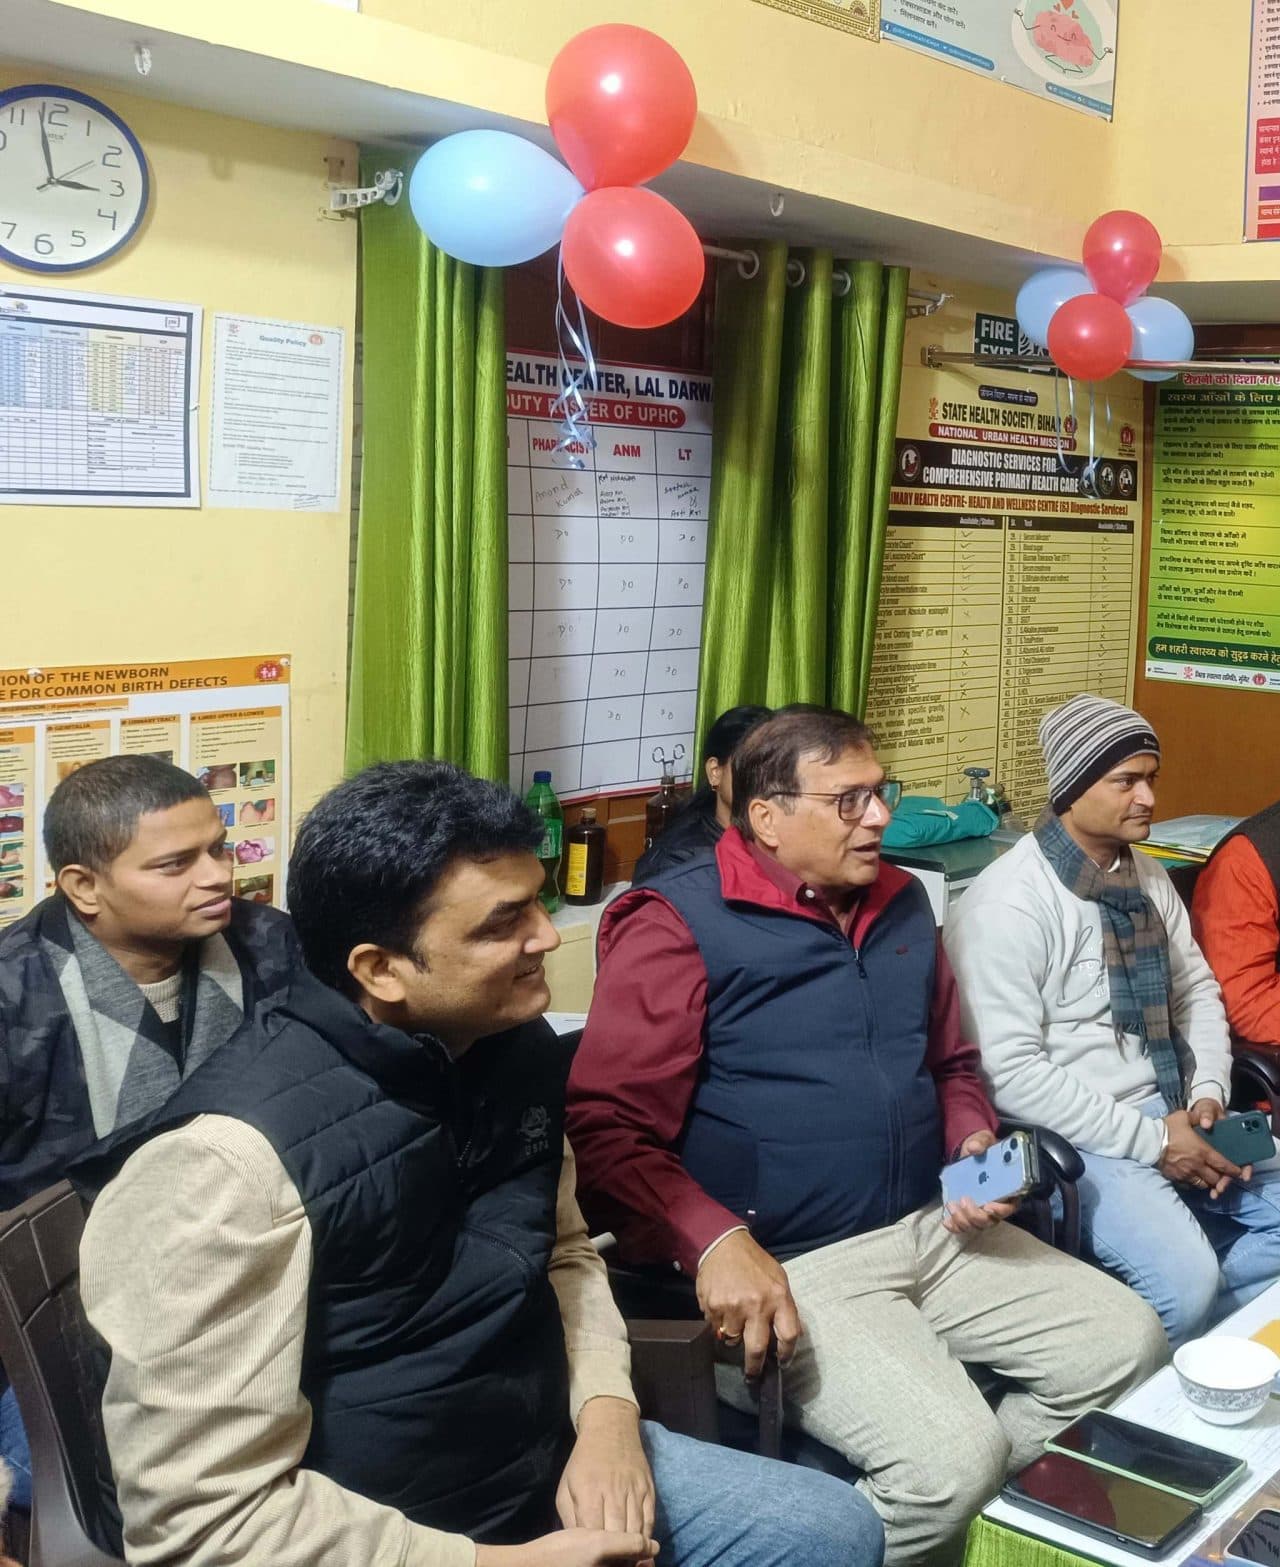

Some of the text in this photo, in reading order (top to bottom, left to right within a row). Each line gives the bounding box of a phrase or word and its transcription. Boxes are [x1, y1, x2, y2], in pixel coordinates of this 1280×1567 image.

[10, 107, 25, 126] 11
[86, 120, 91, 136] 1
[102, 145, 122, 168] 2
[110, 180, 125, 197] 3
[97, 209, 117, 231] 4
[1, 221, 17, 240] 7
[70, 230, 86, 247] 5
[34, 234, 54, 255] 6
[981, 319, 1014, 341] FIRE
[286, 337, 307, 348] Policy
[507, 360, 557, 386] EALTH
[635, 376, 664, 397] LAL
[669, 379, 711, 402] DARW
[1234, 394, 1246, 403] के
[1250, 394, 1273, 403] लिए
[614, 405, 633, 420] OF
[638, 407, 678, 424] UPHC
[942, 403, 967, 421] STATE
[969, 406, 1000, 426] HEALTH
[1002, 410, 1036, 432] SOCIETY,
[532, 438, 589, 454] PHARCIST
[939, 427, 1069, 449] NATIONAL URBAN HEALTH MISSON
[613, 444, 641, 457] ANM
[679, 448, 692, 461] LT
[952, 448, 1057, 473] DIAGNOSTIC SERVICES FOR
[923, 467, 1079, 493] COMPREHENSIVE PRIMARY HEALTH CARE
[891, 491, 914, 505] IMARY
[915, 493, 938, 506] HEALTH
[969, 496, 991, 508] HEALTH
[992, 498, 1005, 509] AND
[1006, 498, 1037, 510] WELLNESS
[1037, 500, 1059, 512] CENTRE
[1071, 502, 1100, 515] Diagnostic
[1155, 643, 1167, 653] हम
[1169, 643, 1188, 654] शहरी
[1218, 647, 1229, 658] को
[1250, 652, 1269, 662] करने
[34, 673, 55, 684] OF
[61, 672, 89, 682] THE
[94, 667, 169, 681] NEWBORN
[10, 688, 40, 699] FOR
[45, 684, 115, 697] COMMON
[122, 681, 163, 692] BIRTH
[170, 676, 227, 689] DEFECTS
